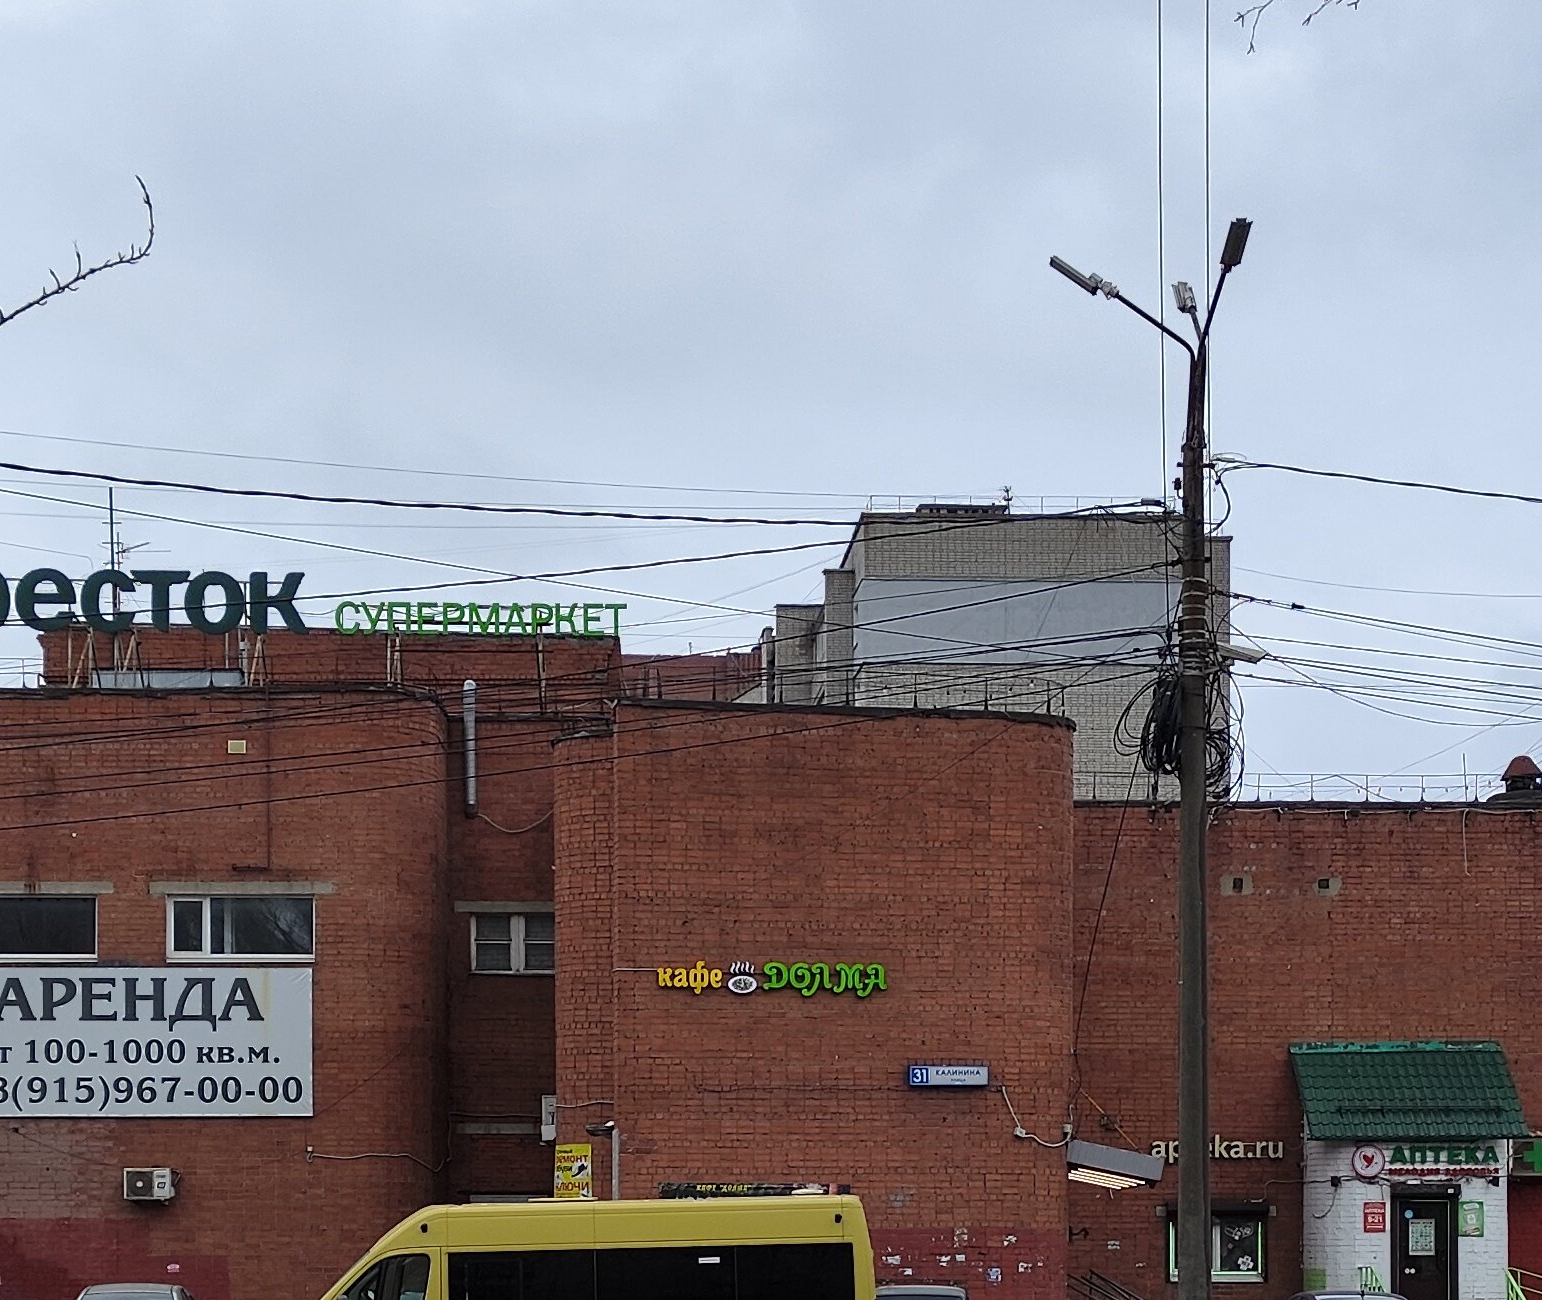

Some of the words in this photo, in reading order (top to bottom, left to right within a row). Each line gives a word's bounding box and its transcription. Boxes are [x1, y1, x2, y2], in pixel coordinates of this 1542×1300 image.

[335, 601, 628, 637] СУПЕРМАРКЕТ
[657, 960, 723, 995] кафе
[762, 961, 888, 997] ДОЛМА
[24, 1038, 186, 1064] 100-1000
[196, 1045, 281, 1064] кв.м.
[912, 1068, 927, 1083] 31
[1151, 1134, 1284, 1164] apka.ru
[1389, 1145, 1500, 1165] АПТЕКА
